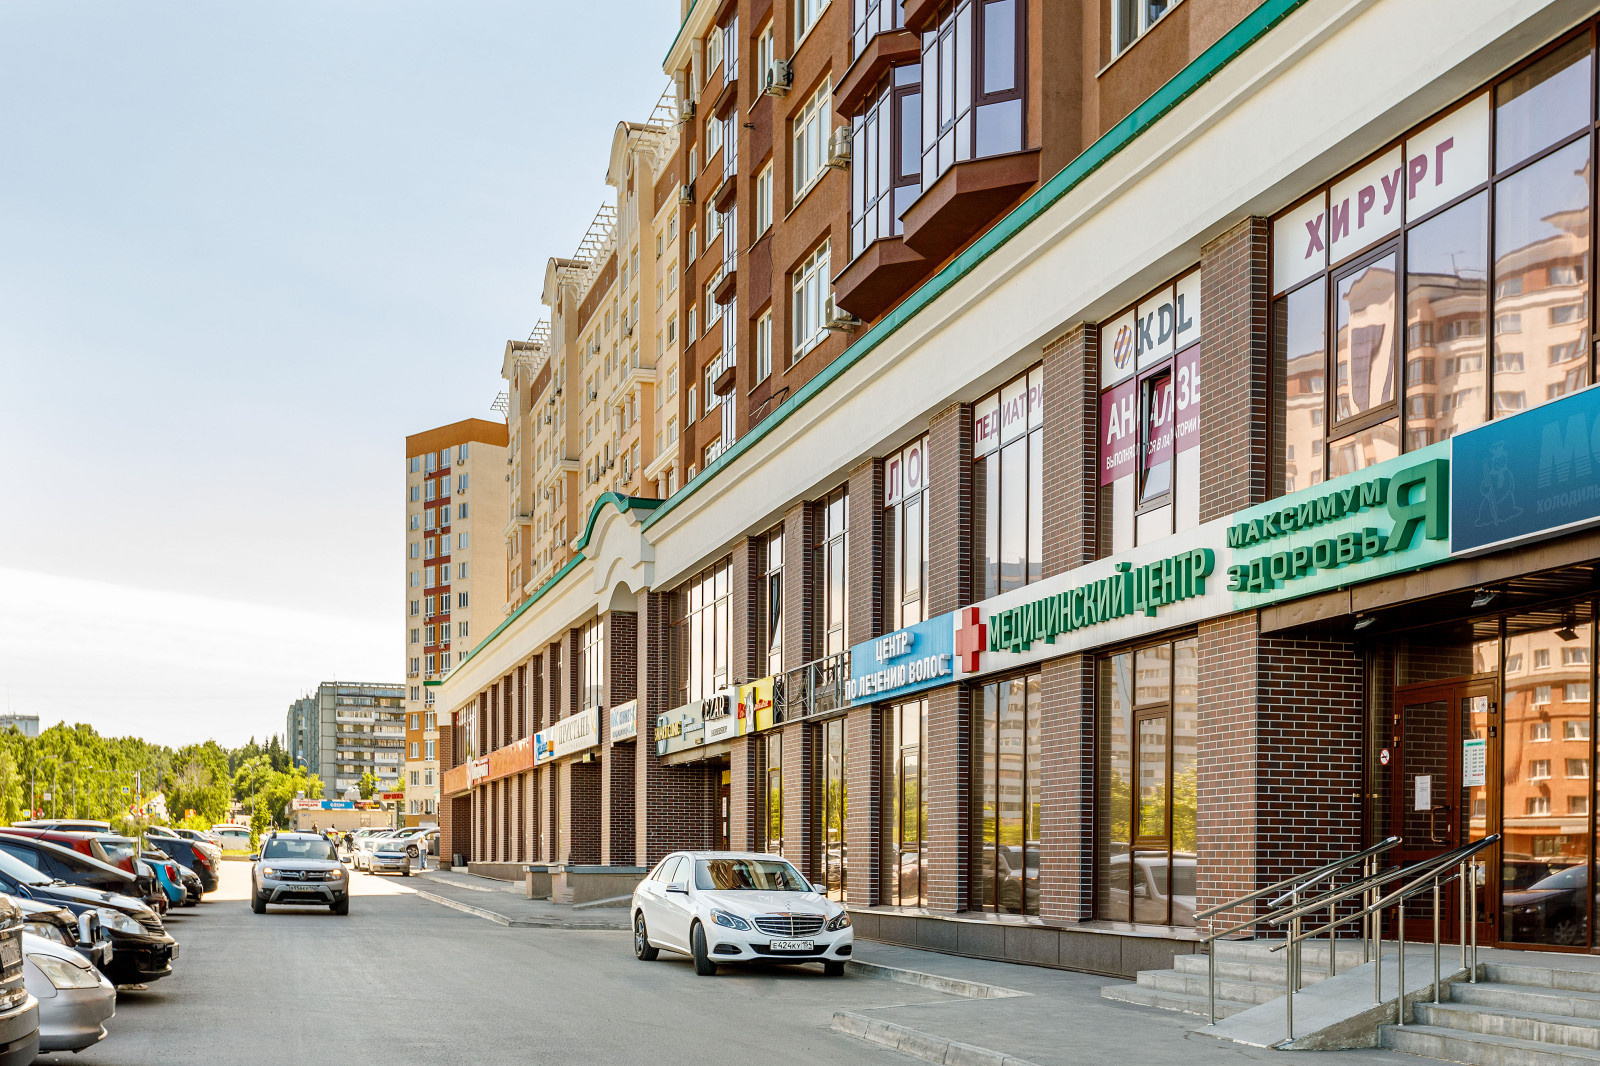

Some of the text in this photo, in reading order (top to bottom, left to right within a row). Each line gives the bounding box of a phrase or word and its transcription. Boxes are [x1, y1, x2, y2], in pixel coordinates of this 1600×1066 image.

[1304, 136, 1454, 260] ХИРУРГ
[1138, 293, 1193, 357] KDL
[1226, 477, 1391, 549] МАКСИМУМ
[988, 548, 1215, 654] МЕДИЦИНСКИЙ ЦЕНТР
[844, 653, 952, 700] ПО ЛЕЧЕНИЮ ВОЛОС
[875, 631, 915, 665] ЦЕНТР
